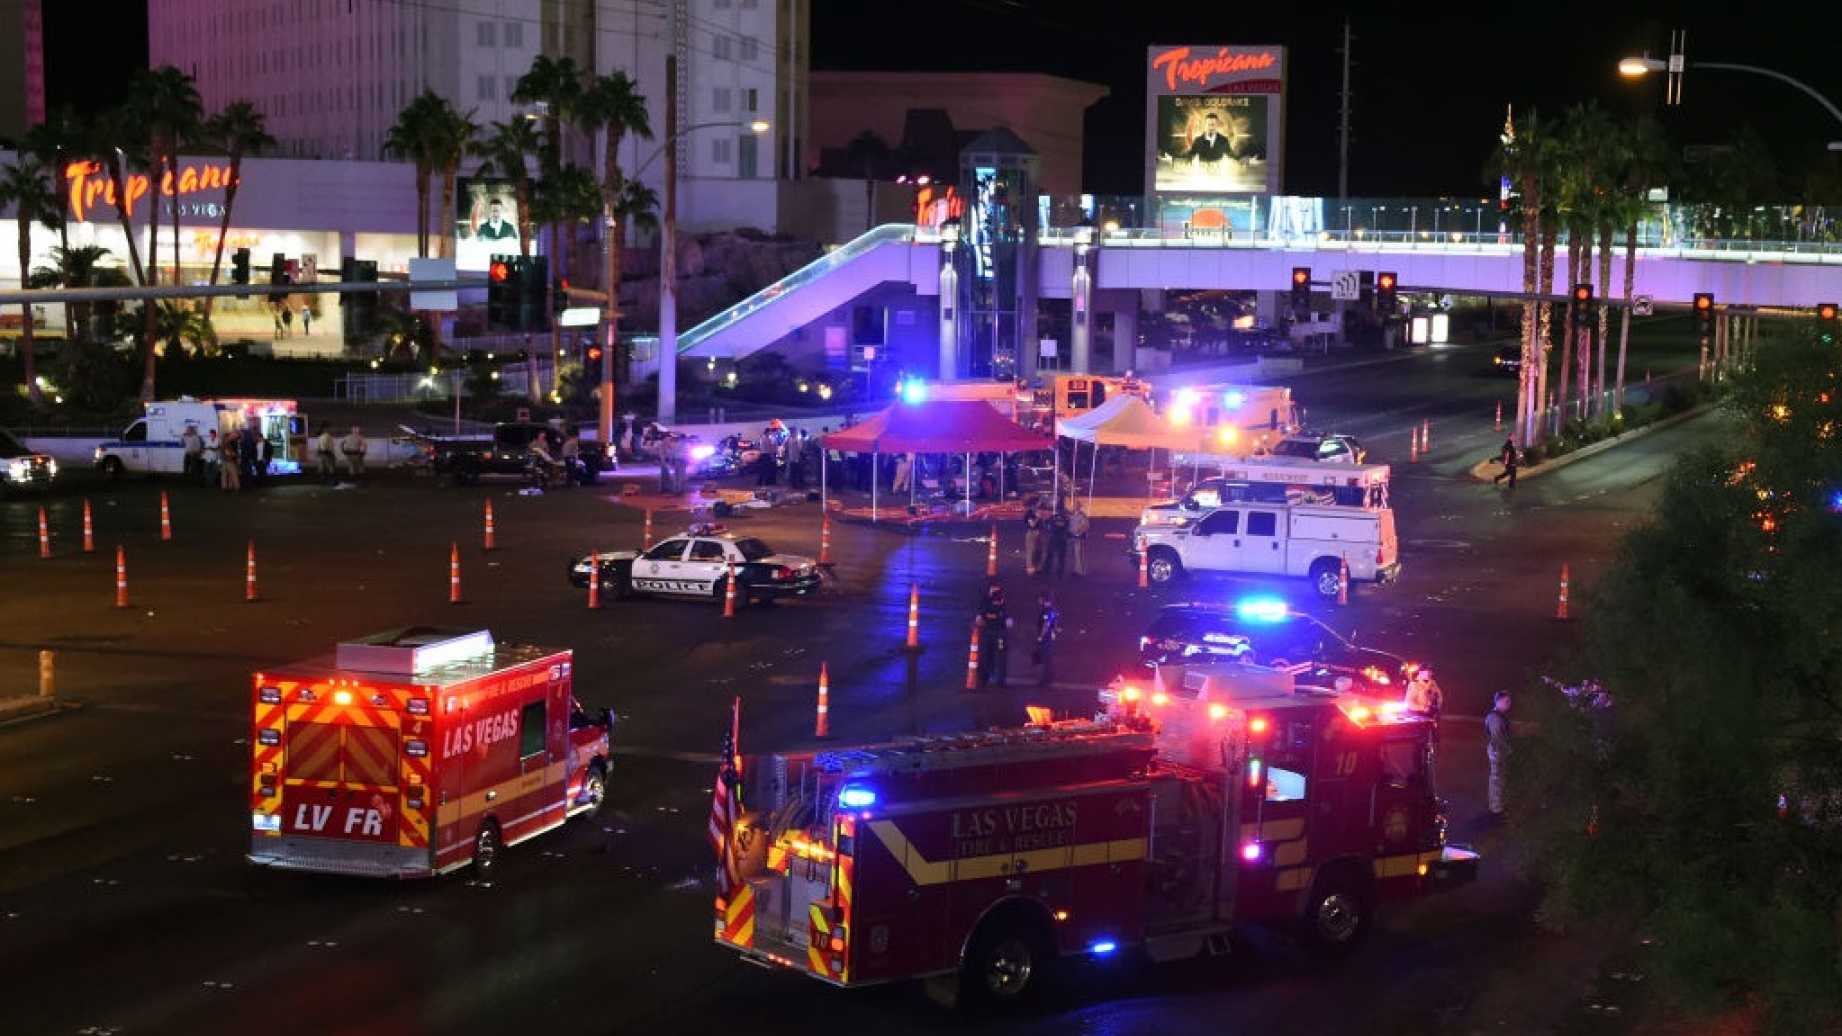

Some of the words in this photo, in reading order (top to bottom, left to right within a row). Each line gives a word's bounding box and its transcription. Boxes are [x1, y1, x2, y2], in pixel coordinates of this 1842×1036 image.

[1152, 46, 1276, 94] Tropicana
[636, 580, 710, 592] POLICE
[442, 723, 474, 759] LAS
[476, 708, 520, 746] VEGAS
[1336, 751, 1358, 776] 10
[294, 803, 333, 832] LV
[344, 807, 383, 837] FR
[952, 809, 996, 839] LAS
[1006, 801, 1077, 831] VEGAS
